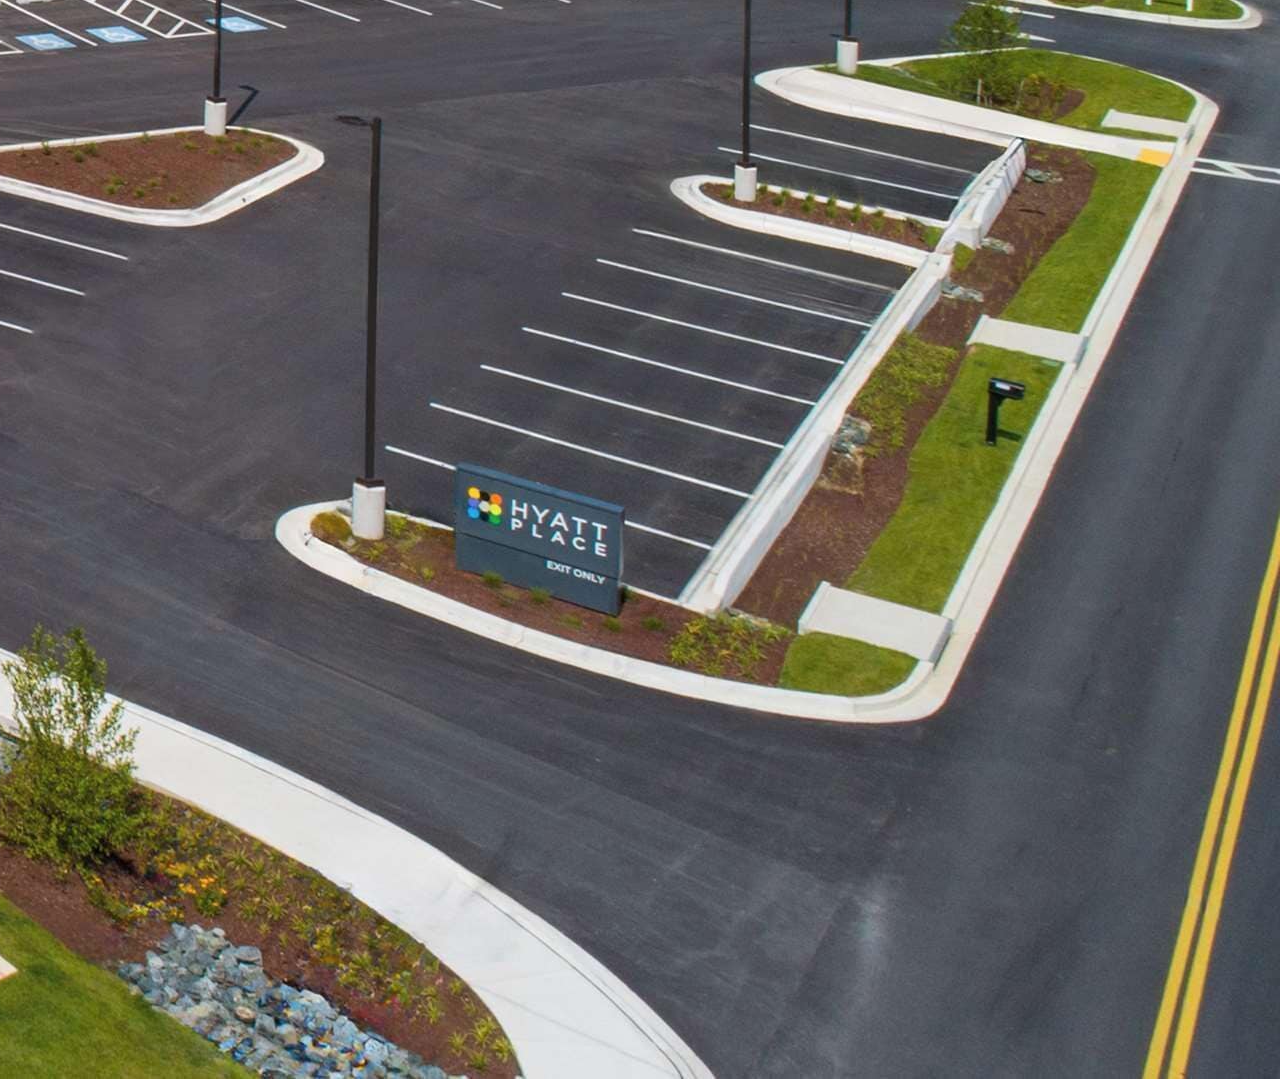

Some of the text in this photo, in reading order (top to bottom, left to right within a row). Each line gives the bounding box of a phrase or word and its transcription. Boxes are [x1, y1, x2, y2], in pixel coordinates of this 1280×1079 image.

[511, 499, 608, 541] HYATT
[511, 517, 608, 557] PLACE
[546, 560, 606, 585] EXIT ONLY
